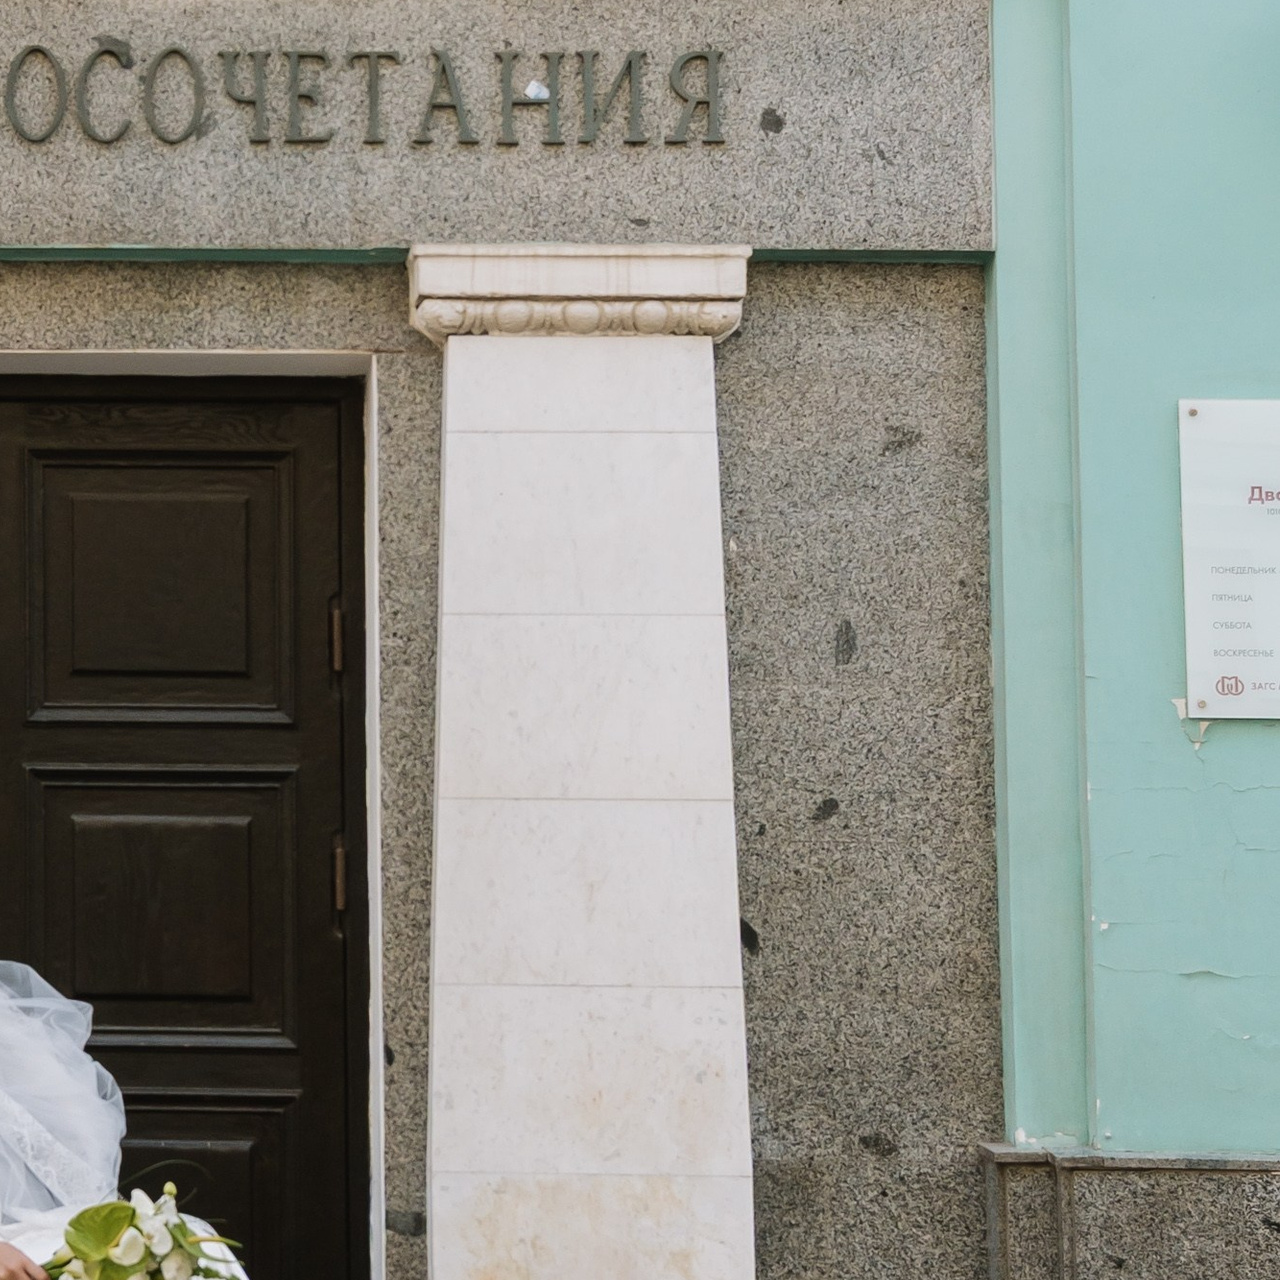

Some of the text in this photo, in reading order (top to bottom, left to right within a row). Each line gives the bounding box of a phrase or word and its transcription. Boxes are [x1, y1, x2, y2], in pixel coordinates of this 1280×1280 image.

[1210, 566, 1277, 575] ПОНЕДЕЛЬНИК
[1211, 594, 1253, 602] ПЯТНИЦА
[1212, 621, 1252, 630] СУББОТА
[1213, 649, 1274, 657] ВОСКРЕСЕНЬЕ
[1251, 682, 1276, 690] ЗАГС
